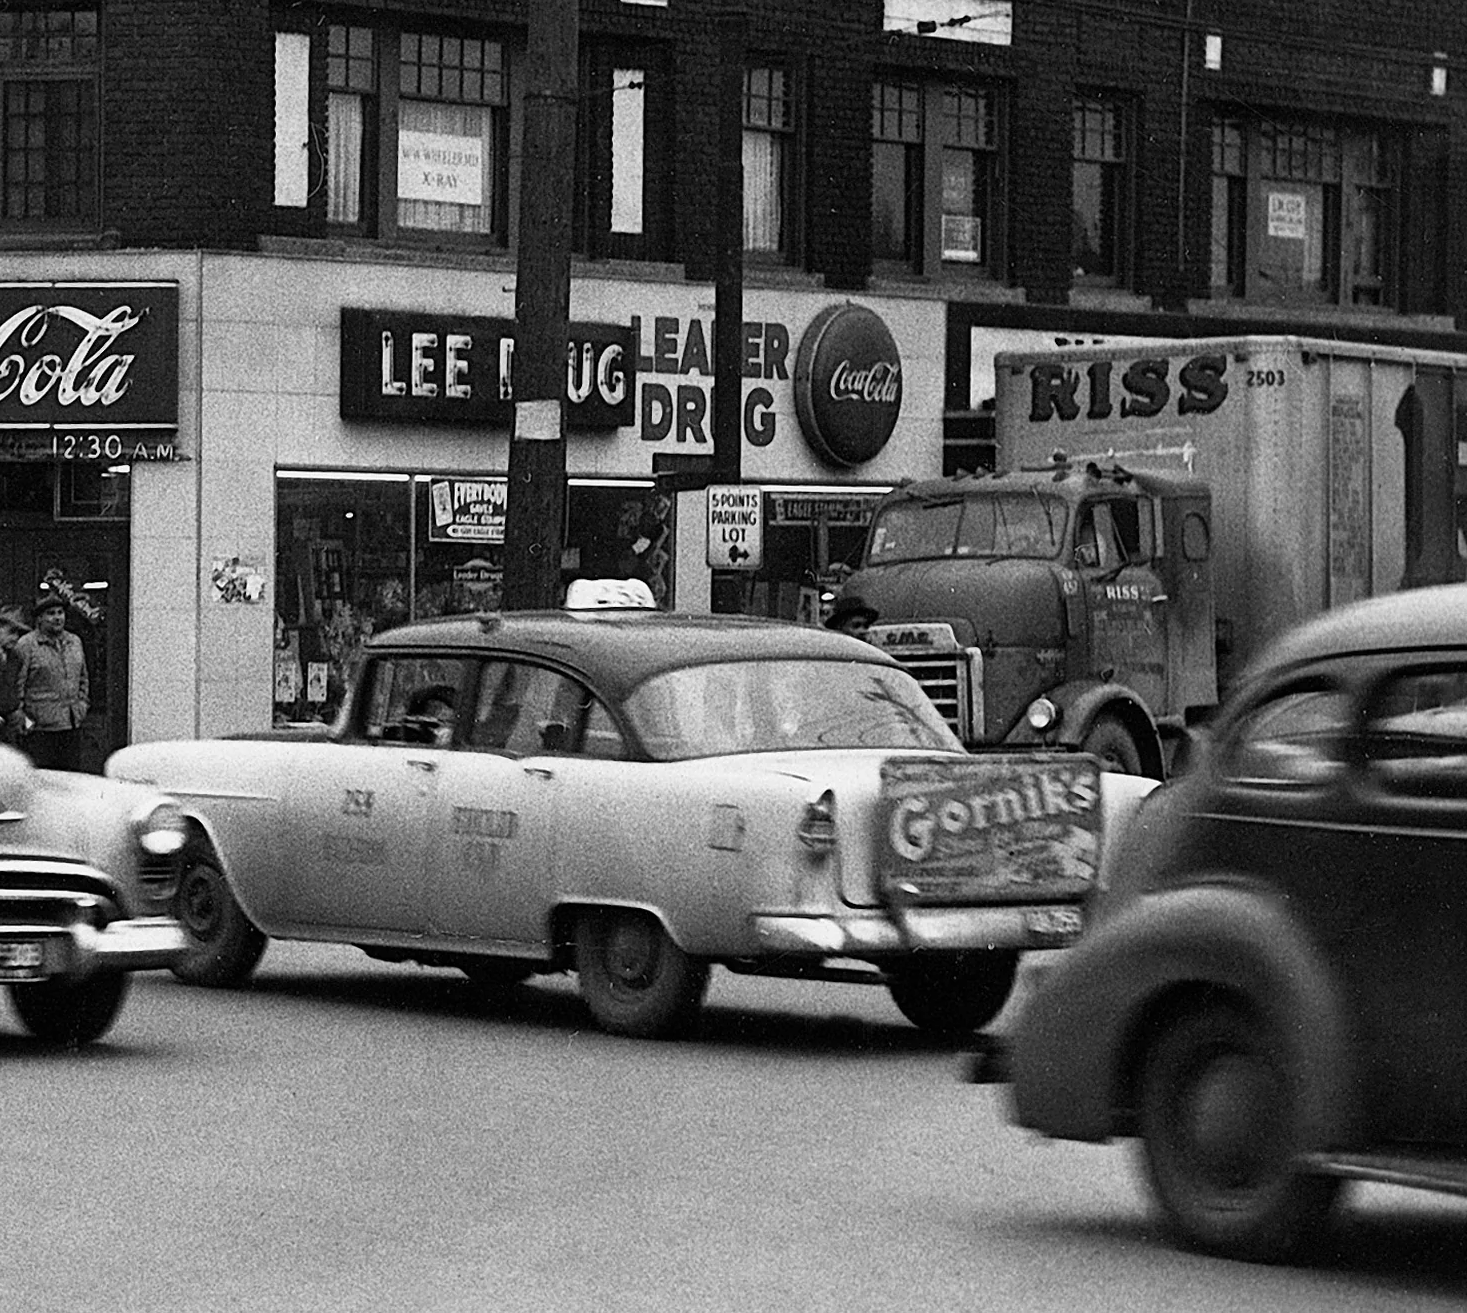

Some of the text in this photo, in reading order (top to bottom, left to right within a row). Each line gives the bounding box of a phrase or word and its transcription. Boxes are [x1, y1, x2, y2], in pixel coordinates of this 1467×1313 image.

[631, 315, 789, 380] LEAER
[382, 330, 628, 406] LEE UG
[1246, 370, 1286, 387] 2503
[1028, 355, 1228, 423] RISS
[640, 383, 777, 447] DRG
[52, 435, 122, 459] 12:30
[454, 482, 508, 511] EVERYBOD
[712, 494, 758, 508] 5 POINTS
[711, 510, 757, 526] PARKING
[722, 528, 746, 542] LOT
